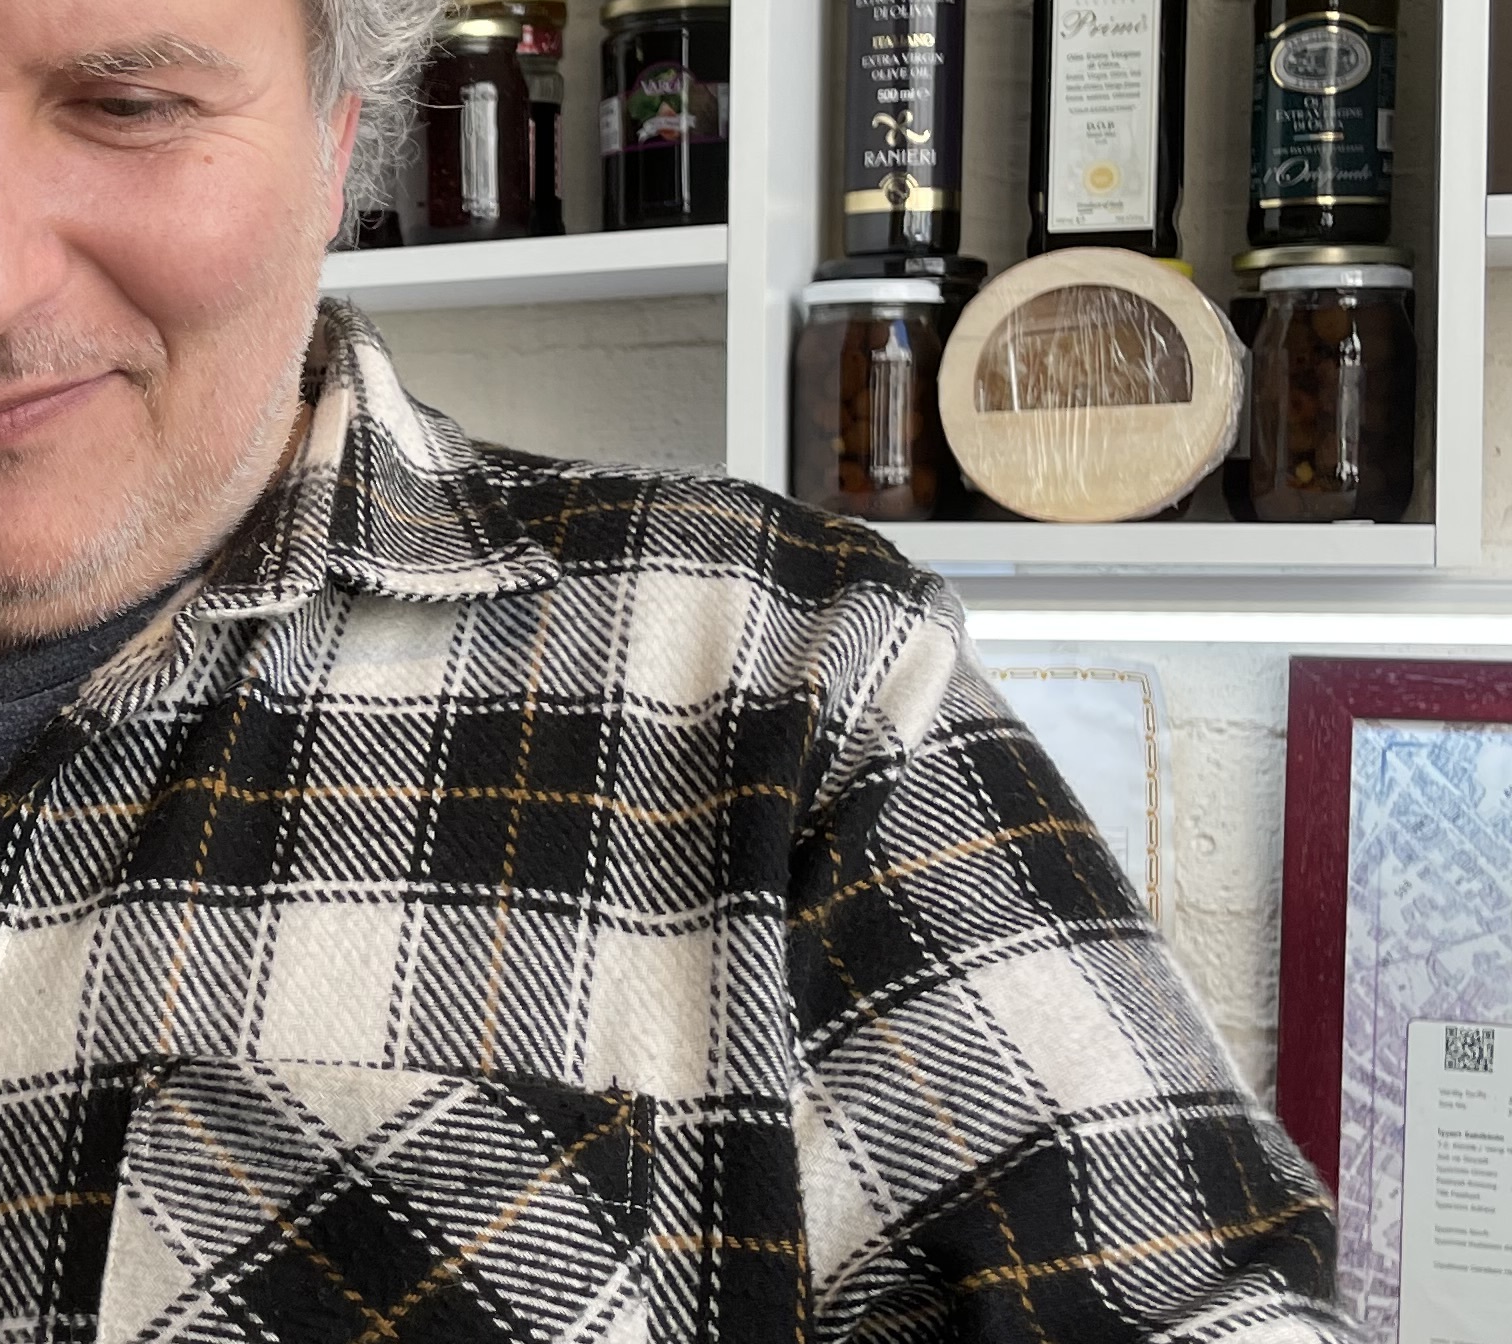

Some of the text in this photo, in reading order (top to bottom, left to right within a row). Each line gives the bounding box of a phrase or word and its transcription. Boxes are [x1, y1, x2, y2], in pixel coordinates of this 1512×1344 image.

[890, 4, 935, 20] OLIVA
[861, 52, 945, 69] EXTRA VIRGIN
[871, 67, 931, 81] OLIVE OIL
[877, 87, 899, 103] 500
[864, 148, 937, 168] RANIERI
